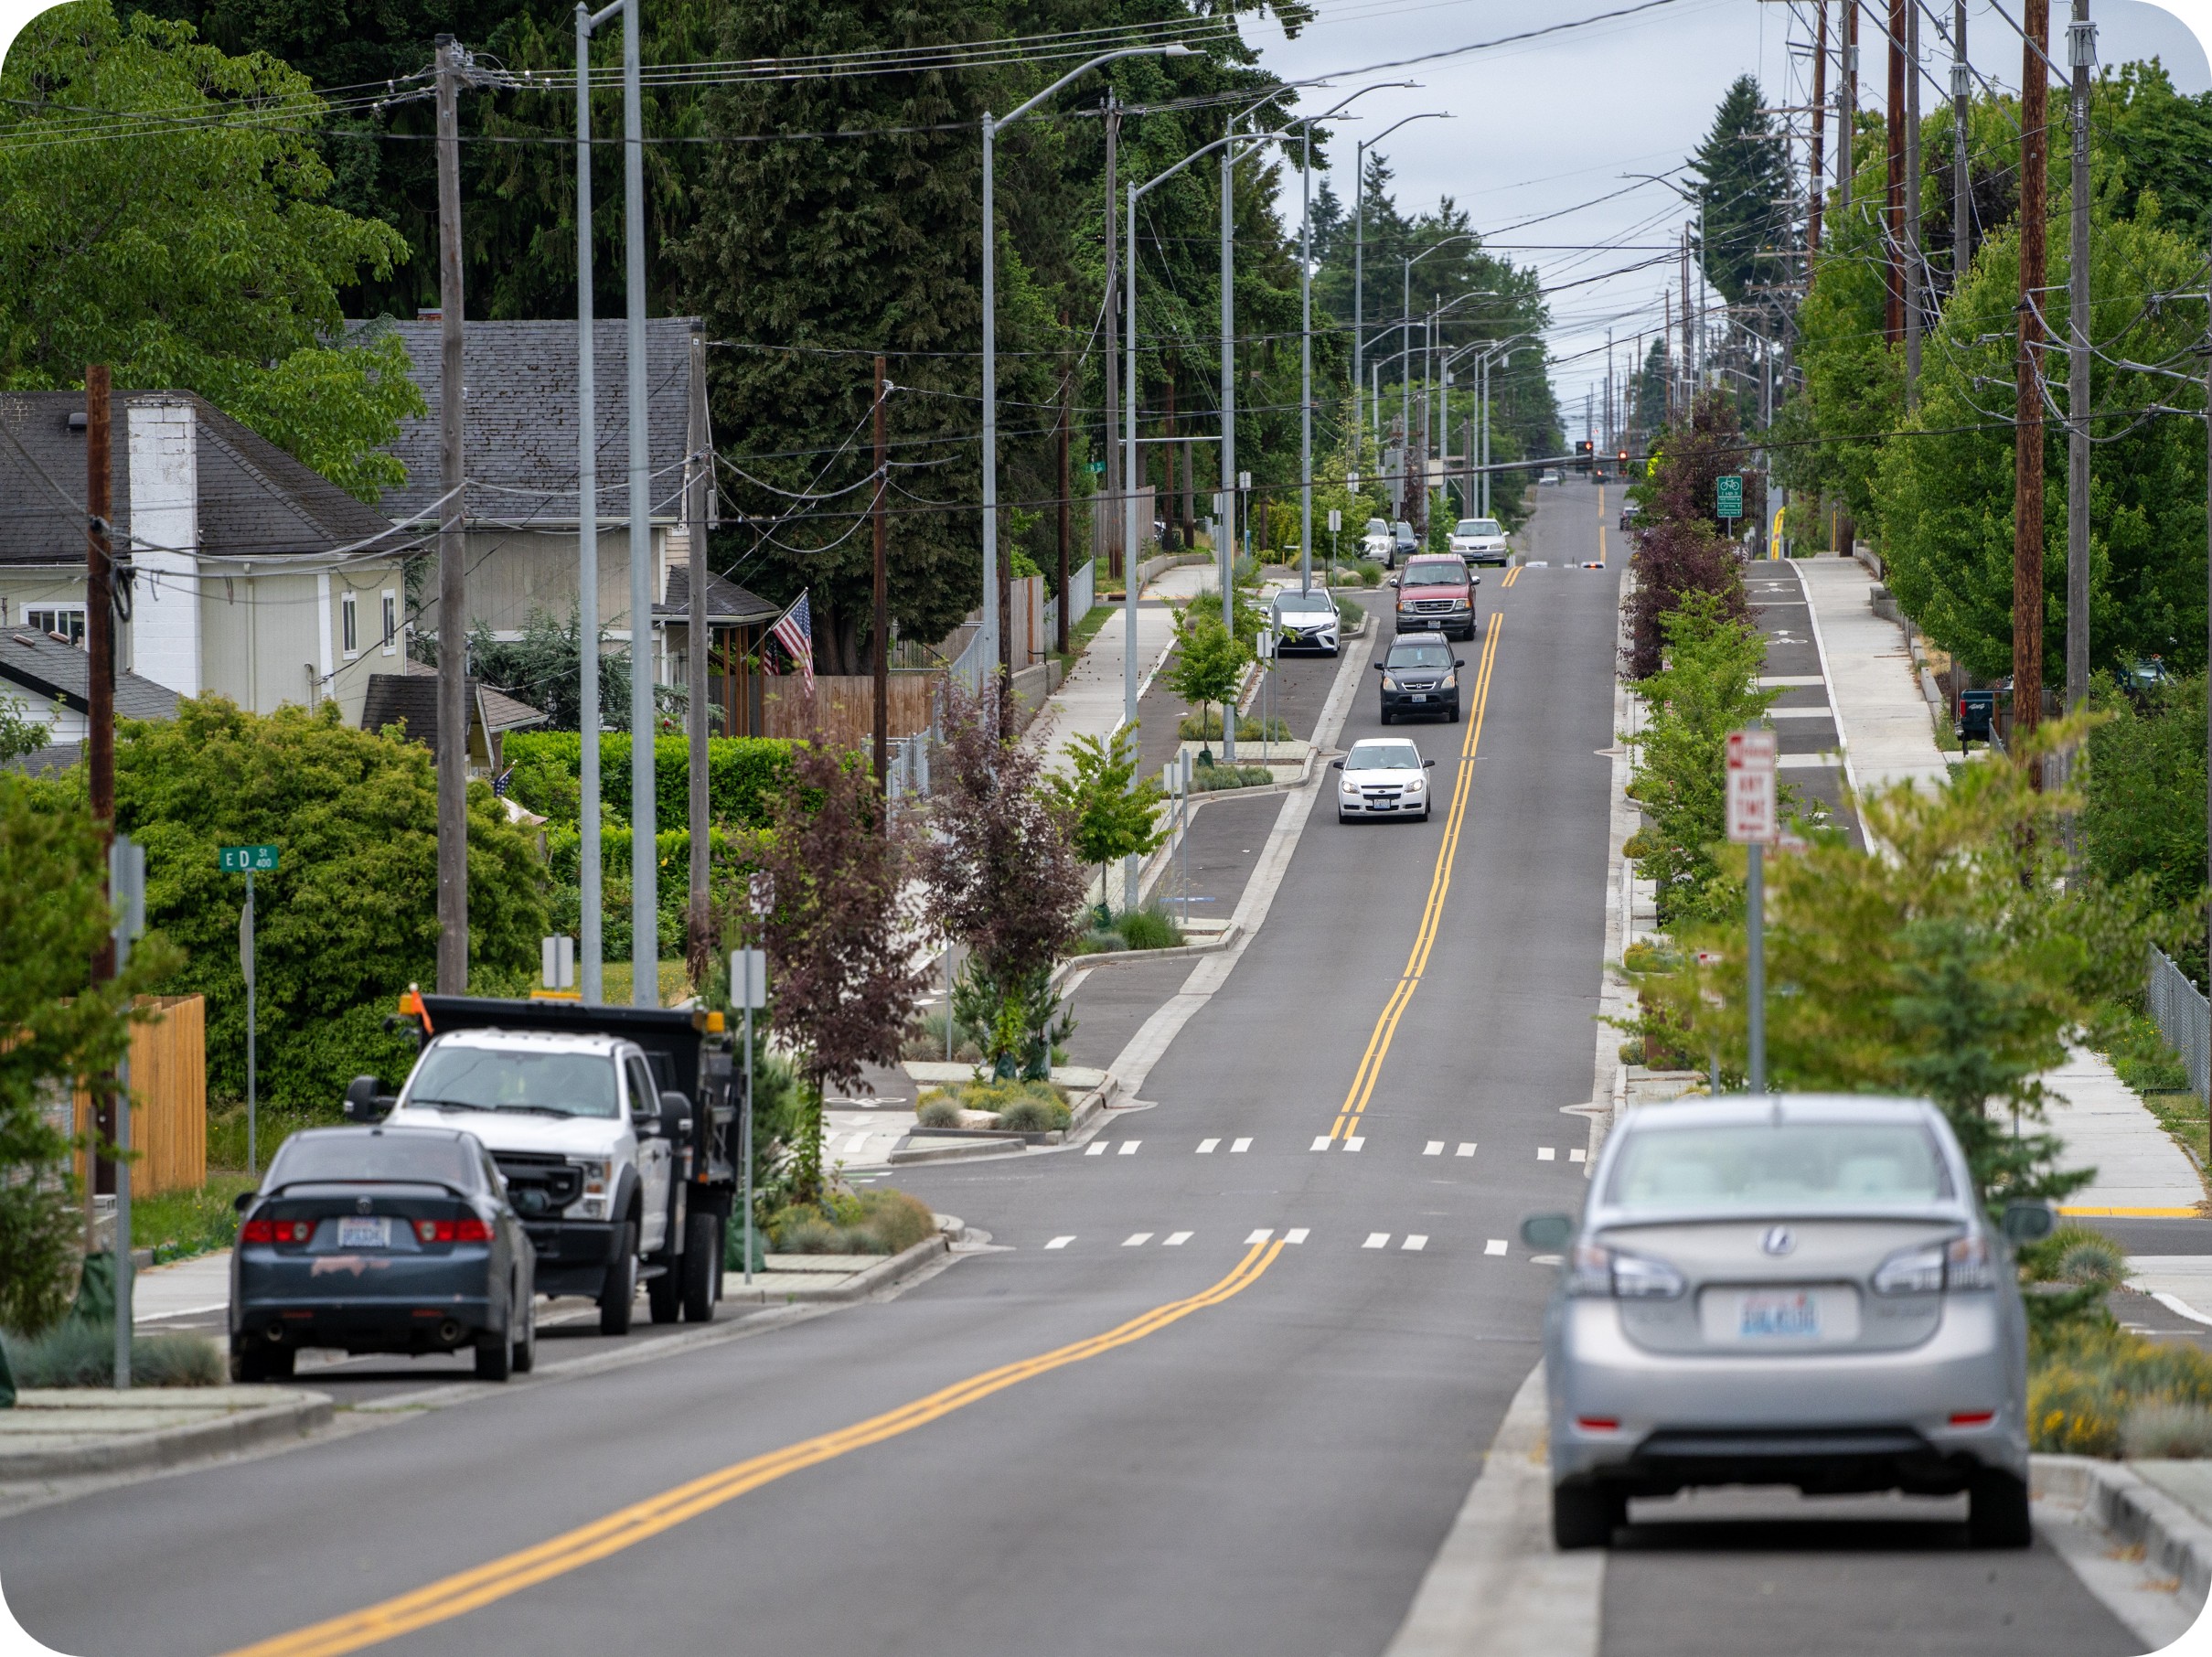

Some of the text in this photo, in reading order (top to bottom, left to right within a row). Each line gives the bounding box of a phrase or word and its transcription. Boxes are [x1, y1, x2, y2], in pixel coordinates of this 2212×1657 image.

[1739, 775, 1764, 792] ANY
[1737, 798, 1766, 818] TIME
[226, 848, 268, 868] E D St
[256, 858, 272, 868] 400
